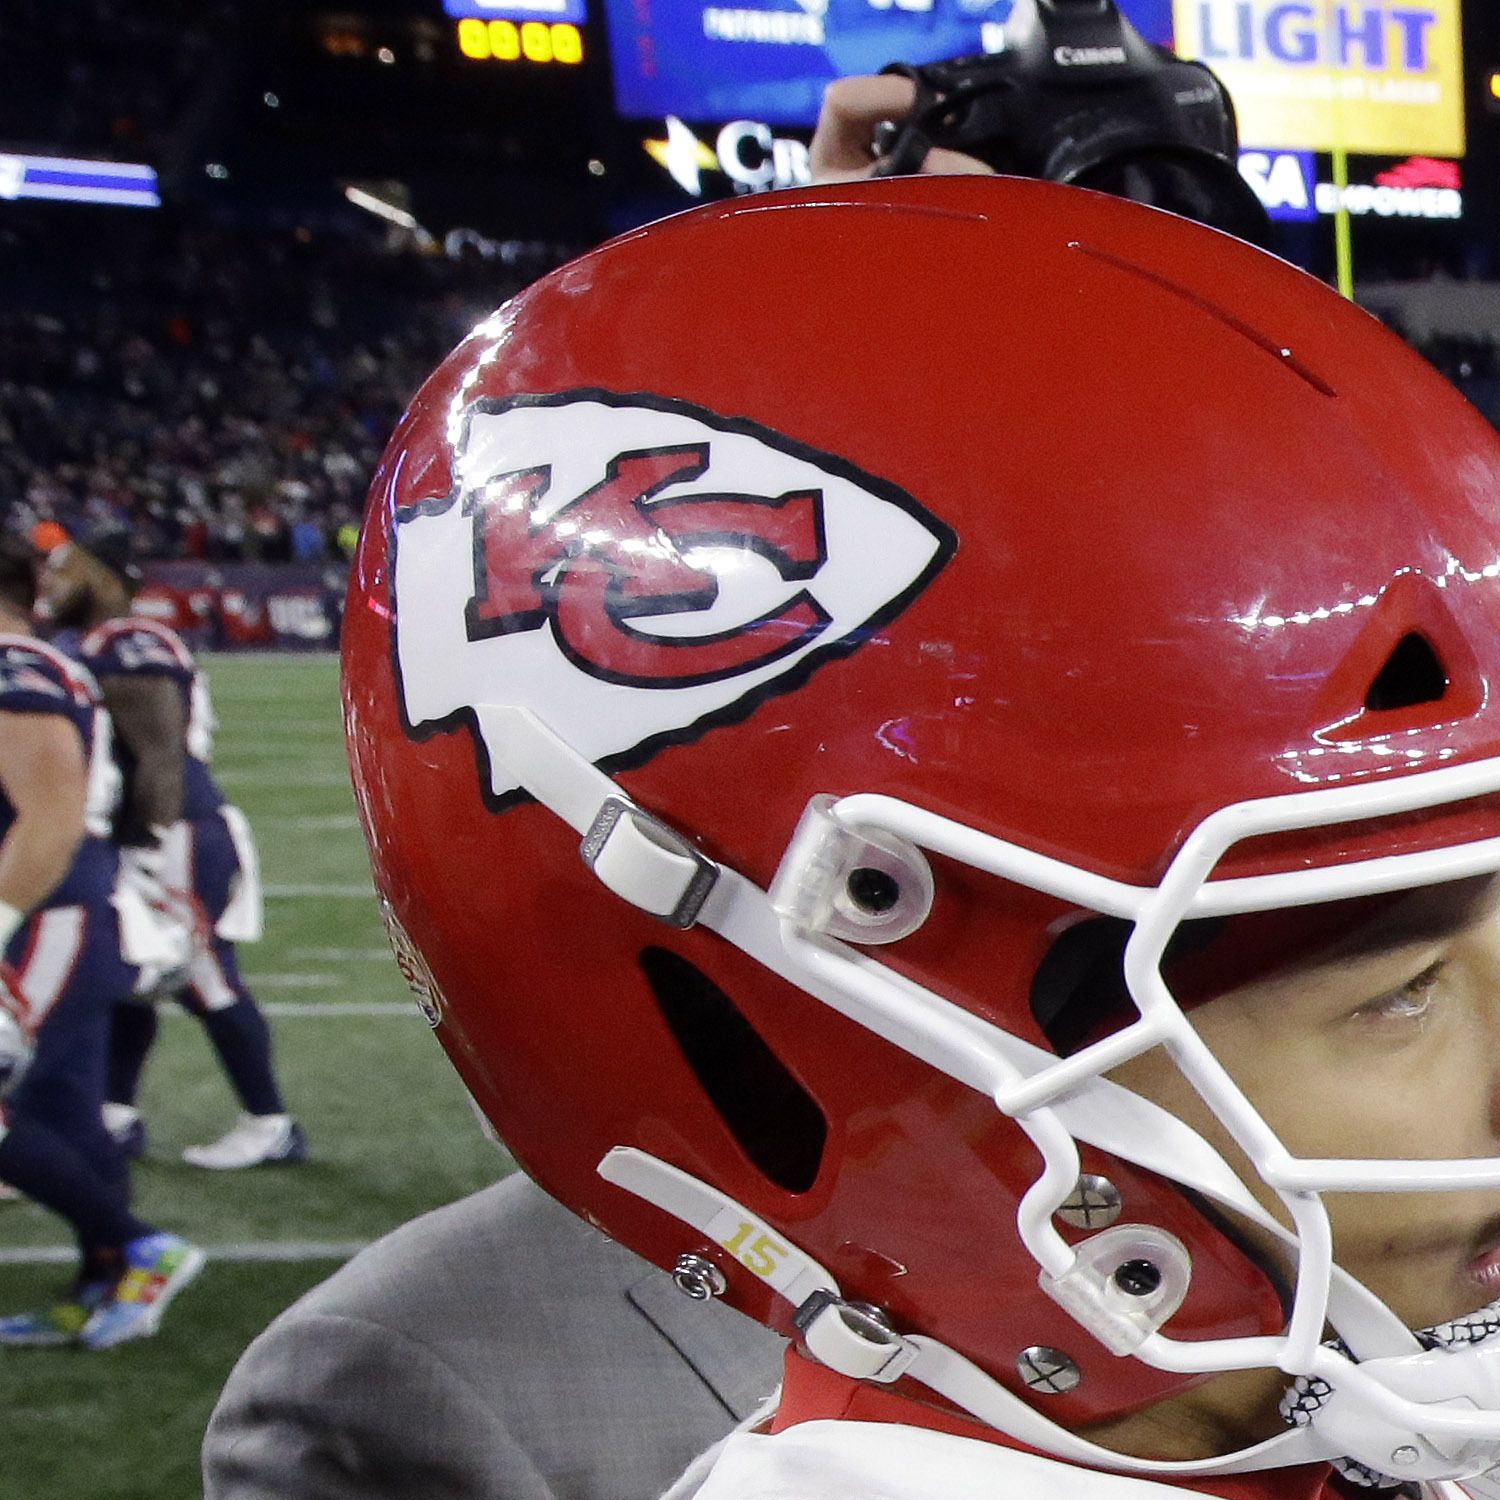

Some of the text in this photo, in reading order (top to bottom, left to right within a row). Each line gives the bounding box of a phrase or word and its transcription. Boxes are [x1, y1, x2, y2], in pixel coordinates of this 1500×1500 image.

[1053, 45, 1127, 66] Canon
[1199, 0, 1435, 72] LIGHT
[1315, 183, 1463, 219] EMPOWER
[463, 442, 834, 690] KC
[721, 1222, 789, 1277] 15
